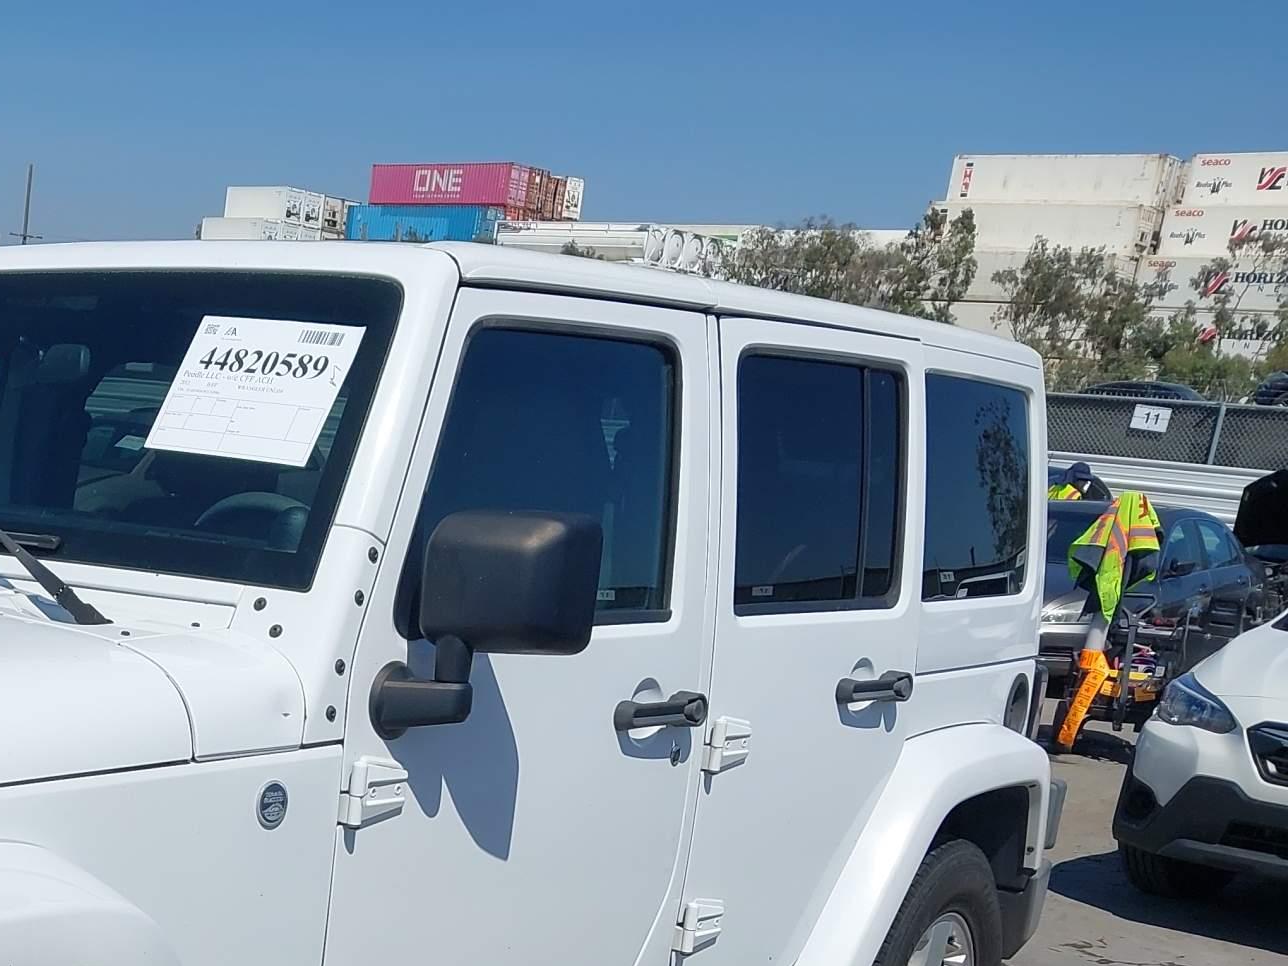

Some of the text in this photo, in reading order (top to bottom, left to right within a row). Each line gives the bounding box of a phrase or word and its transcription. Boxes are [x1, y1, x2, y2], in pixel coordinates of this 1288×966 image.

[1200, 158, 1231, 166] seaco
[413, 168, 463, 192] ONE
[1174, 208, 1204, 217] seaco
[1234, 272, 1288, 283] HORIZ
[200, 346, 329, 379] 44820589
[1144, 411, 1161, 425] 11
